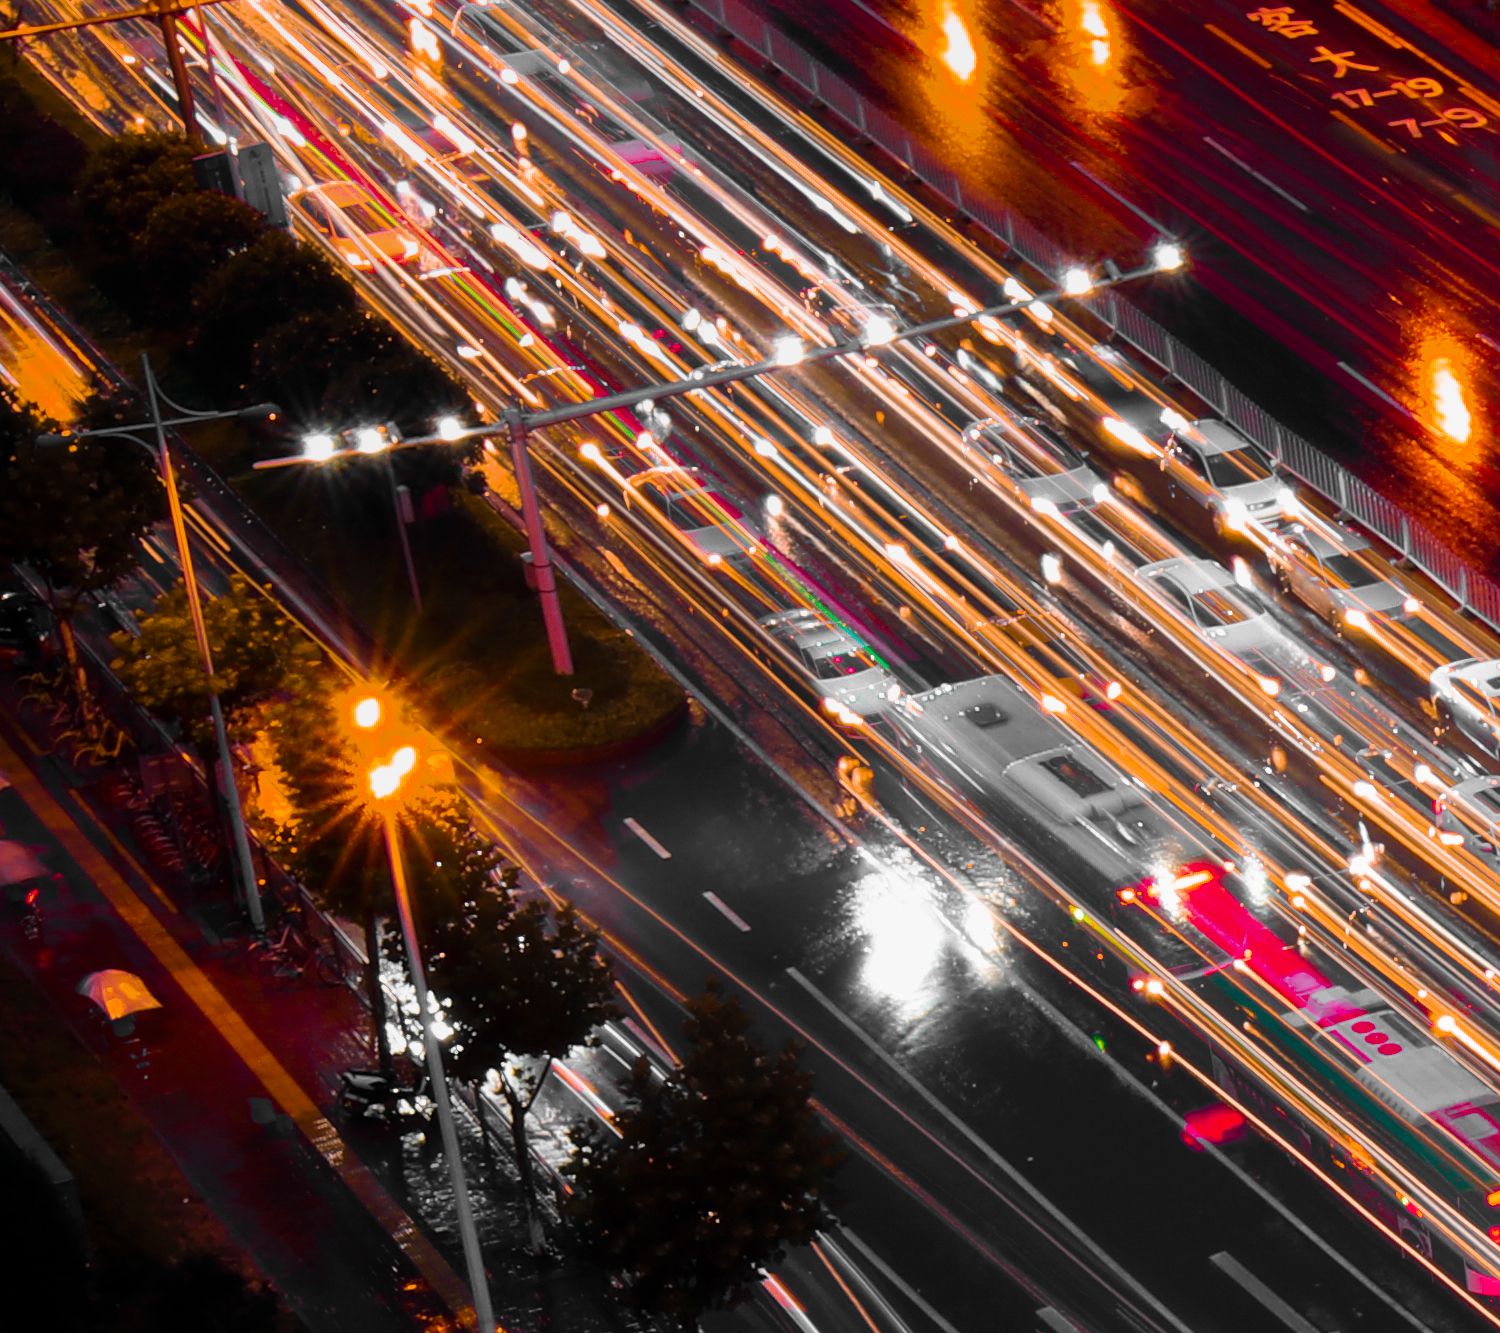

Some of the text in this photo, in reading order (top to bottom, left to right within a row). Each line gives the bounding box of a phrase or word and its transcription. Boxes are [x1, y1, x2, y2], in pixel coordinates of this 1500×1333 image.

[1309, 46, 1380, 78] 大
[1331, 77, 1444, 109] 17-19
[1388, 107, 1488, 139] 7-9
